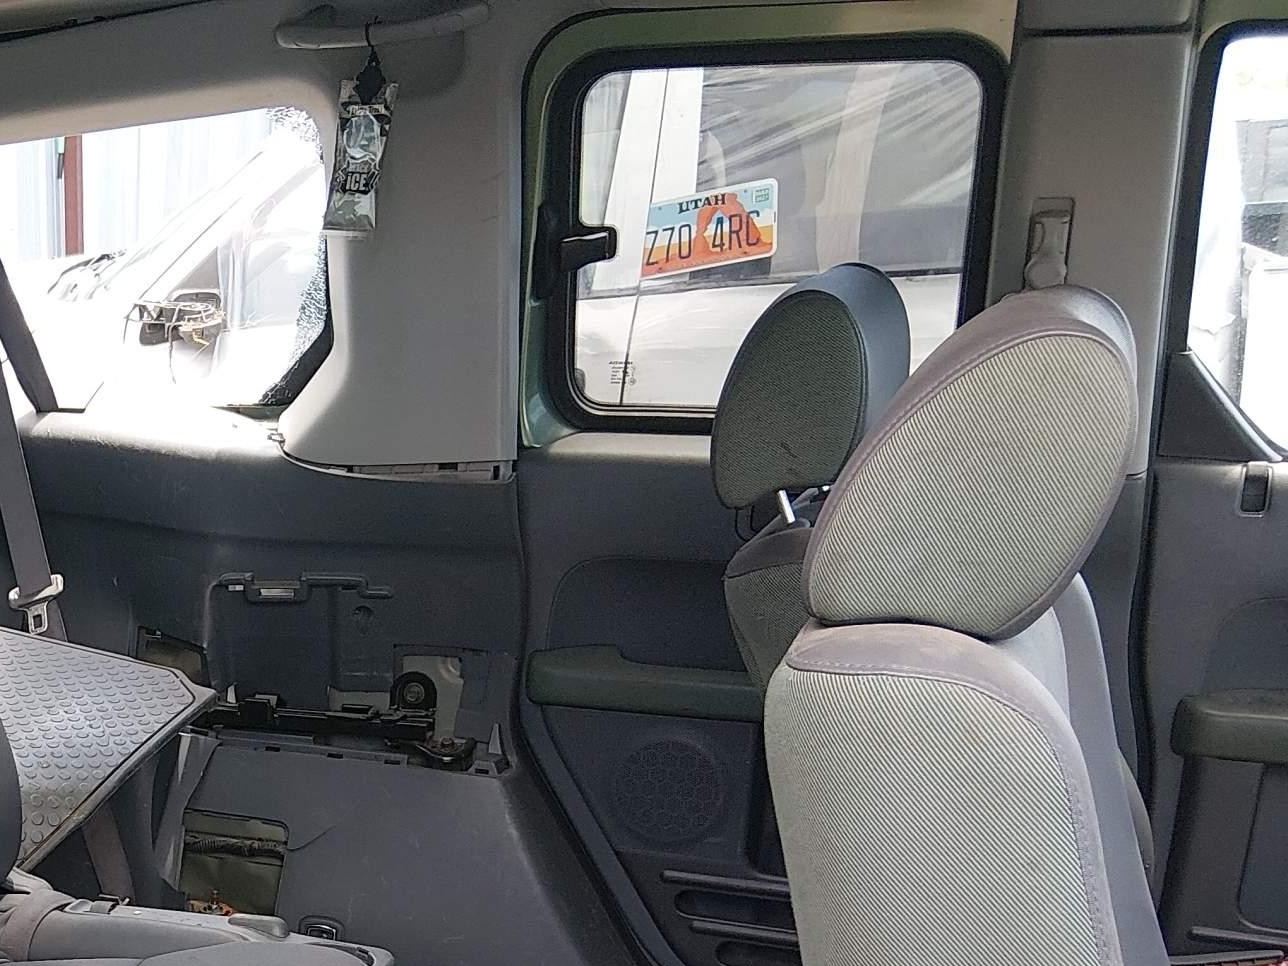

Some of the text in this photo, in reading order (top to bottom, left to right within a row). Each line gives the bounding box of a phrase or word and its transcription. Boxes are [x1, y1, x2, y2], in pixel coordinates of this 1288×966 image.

[678, 193, 726, 214] UTAH
[645, 210, 760, 266] Z70 4RC
